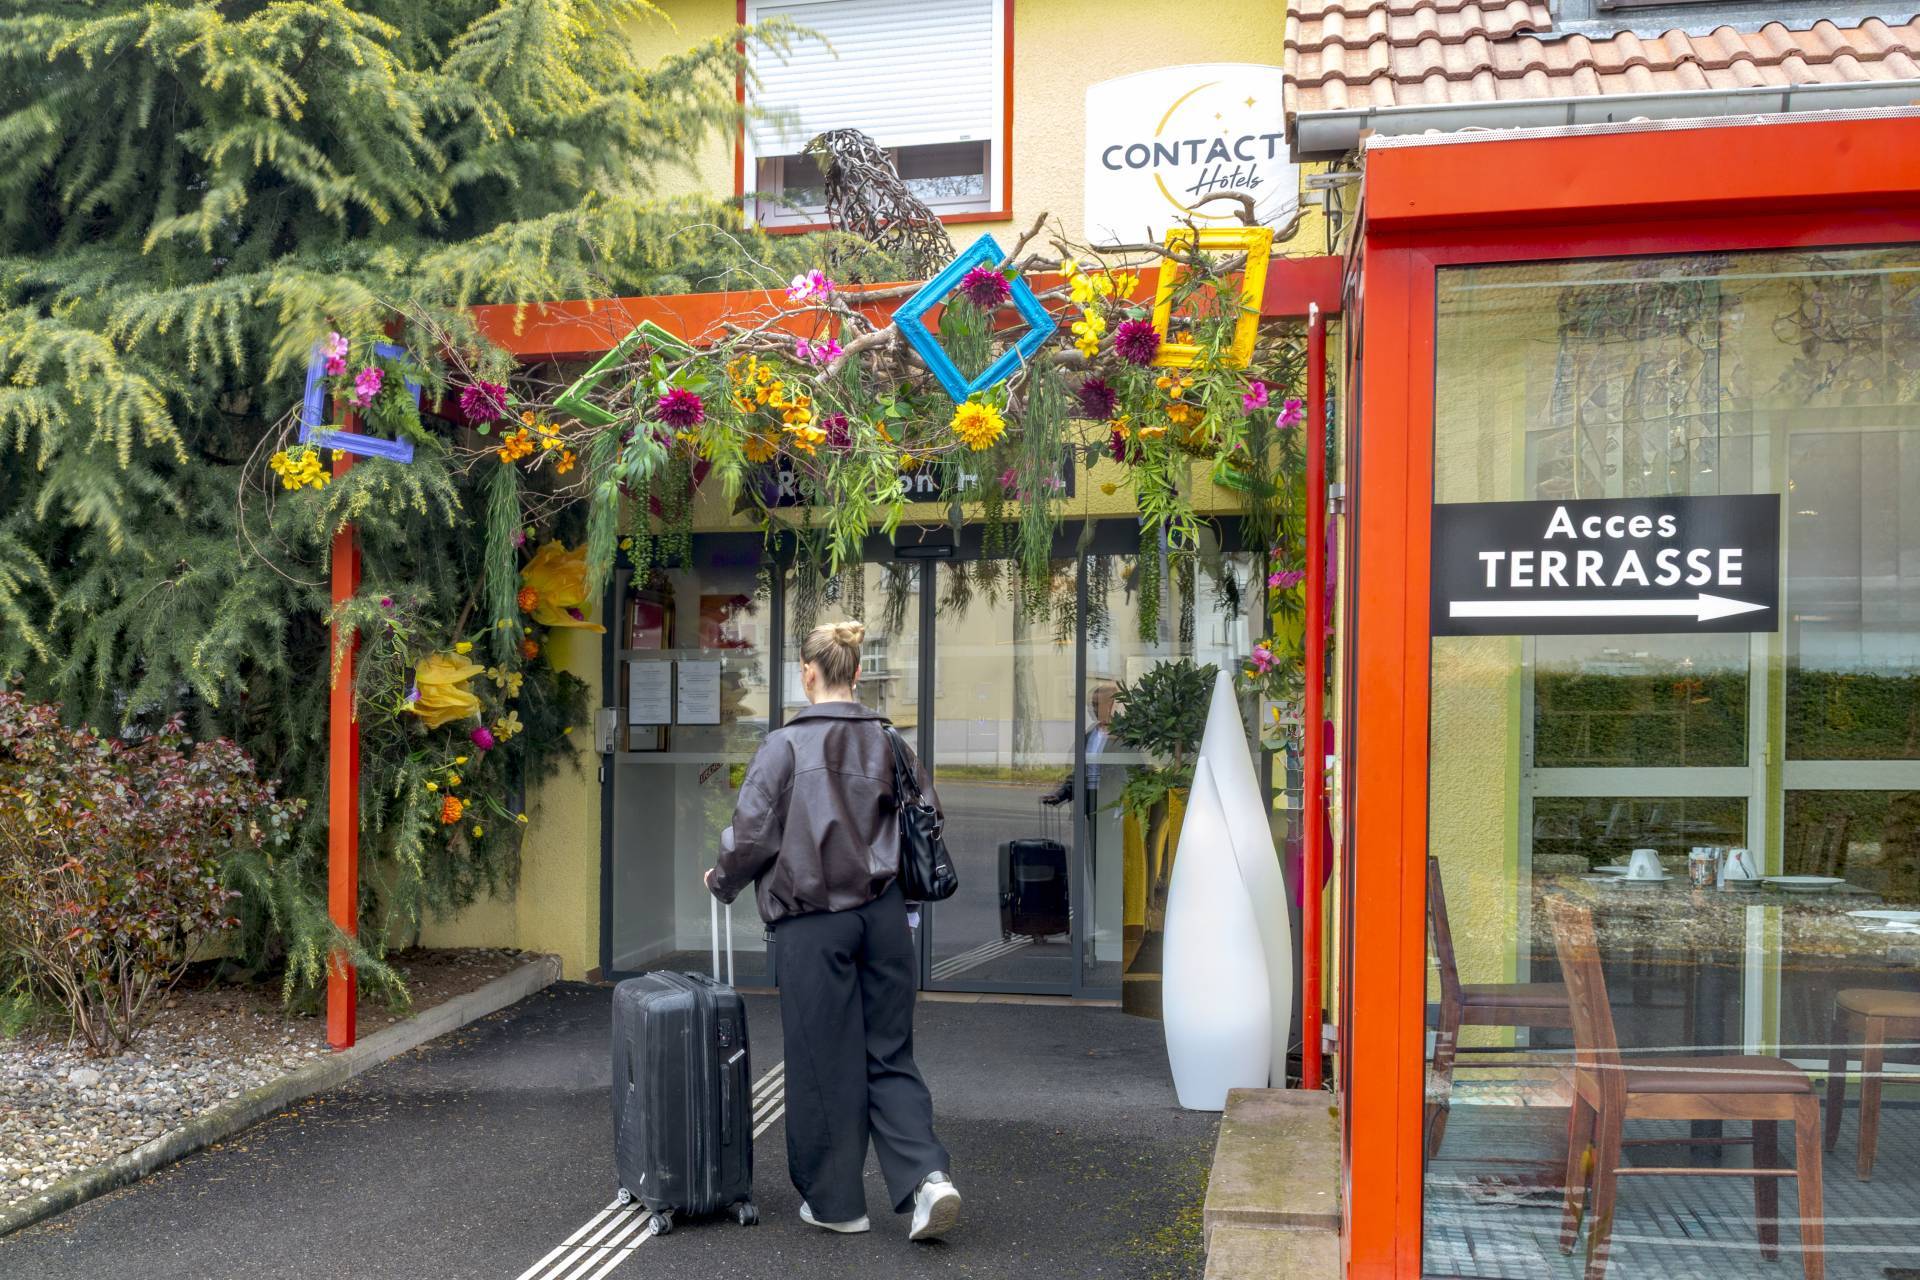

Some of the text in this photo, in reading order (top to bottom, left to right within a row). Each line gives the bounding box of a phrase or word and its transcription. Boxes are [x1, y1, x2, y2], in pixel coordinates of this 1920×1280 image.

[1102, 133, 1285, 170] CONTACT
[1185, 163, 1264, 196] Hôtels
[1543, 506, 1677, 539] Acces
[1479, 548, 1743, 588] TERRASSE
